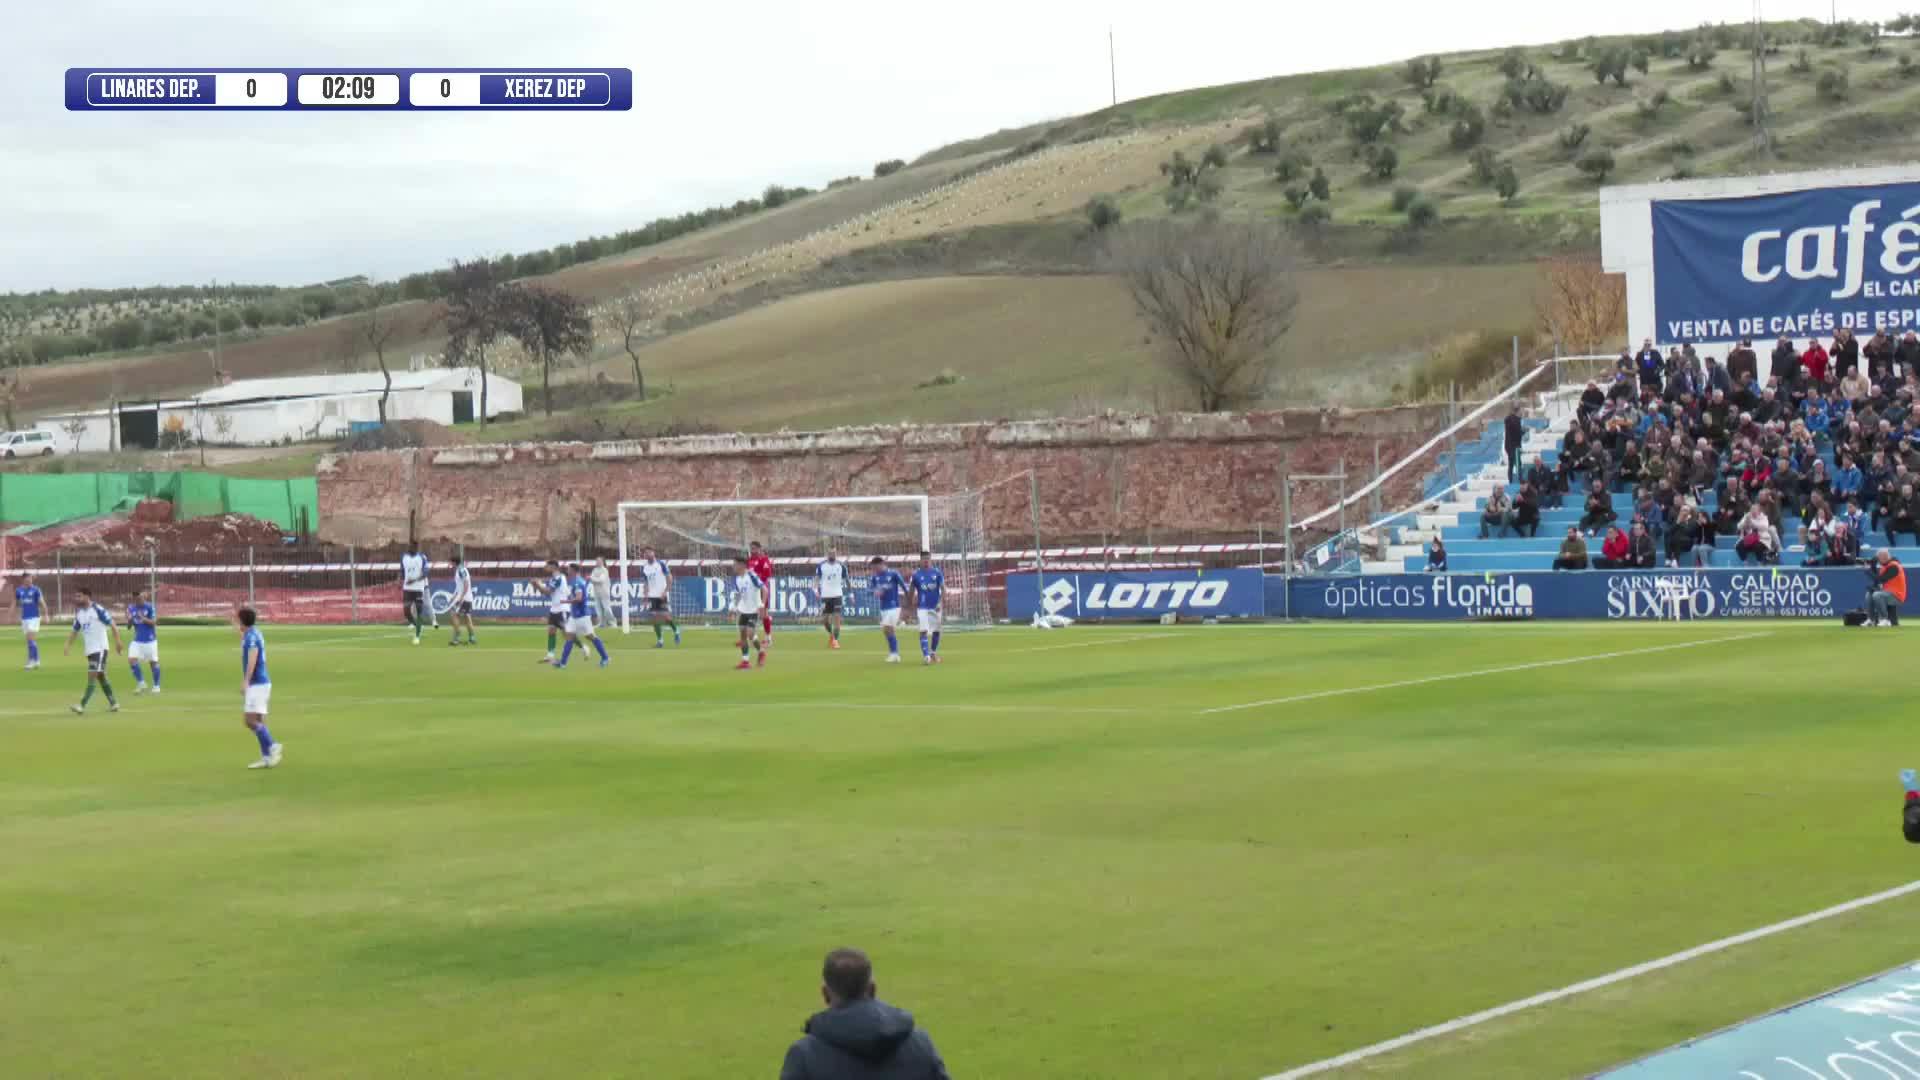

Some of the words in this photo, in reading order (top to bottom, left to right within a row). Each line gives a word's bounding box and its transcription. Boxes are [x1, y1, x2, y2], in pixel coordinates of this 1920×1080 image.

[1863, 281, 1885, 297] EL
[1668, 319, 1733, 339] VENTA
[1739, 317, 1764, 335] DE
[1770, 308, 1834, 333] CAFÉS
[1842, 311, 1868, 329] DE
[1731, 573, 1820, 591] CALIDAD
[1085, 580, 1229, 609] LOTTO
[1325, 581, 1425, 615] ópticas
[1432, 576, 1533, 607] florida
[1607, 588, 1716, 618] SIXTO
[1720, 591, 1732, 607] Y
[1739, 590, 1832, 607] SERVICIO
[1467, 607, 1533, 617] LINARES
